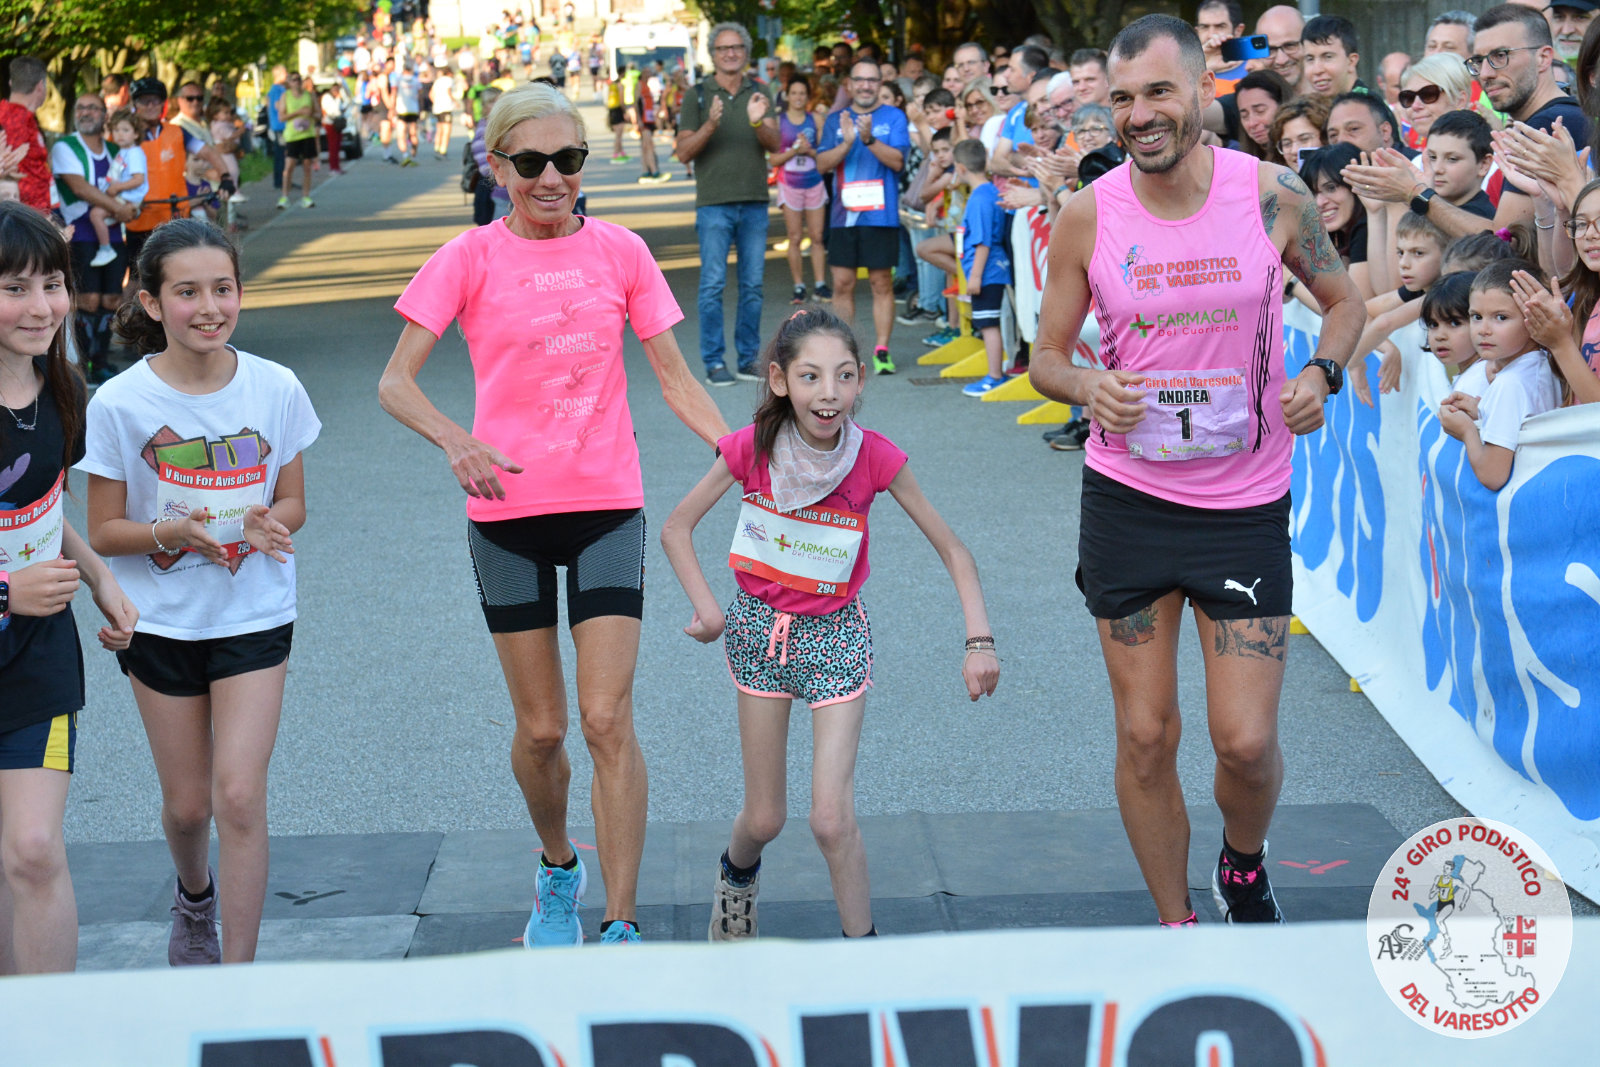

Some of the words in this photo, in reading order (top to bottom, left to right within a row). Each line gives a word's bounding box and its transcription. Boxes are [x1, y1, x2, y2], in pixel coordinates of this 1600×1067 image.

[1134, 263, 1164, 278] GIRO
[1166, 257, 1238, 275] PODISTICO
[534, 269, 584, 286] DONNE
[536, 284, 548, 293] IN
[550, 278, 587, 293] CORSA
[1137, 277, 1160, 292] DEL
[1165, 270, 1242, 289] VARESOTTO
[1157, 308, 1239, 329] FARMACIA
[1158, 328, 1177, 338] Del
[1182, 322, 1239, 336] Cuoricino
[544, 331, 598, 350] DONNE
[546, 347, 558, 356] IN
[560, 341, 598, 355] CORSA
[1145, 377, 1168, 389] Giro
[1169, 376, 1187, 388] del
[1157, 389, 1211, 405] ANDREA
[554, 411, 566, 419] IN
[1175, 406, 1193, 442] 1
[165, 467, 173, 479] V
[173, 471, 194, 485] Run
[196, 475, 214, 487] For
[215, 475, 236, 487] Avis
[237, 474, 245, 485] di
[246, 471, 262, 482] Sera
[15, 511, 32, 526] For
[756, 493, 777, 510] Run
[821, 513, 831, 523] di
[833, 514, 858, 528] Sera
[793, 540, 848, 559] FARMACIA
[816, 582, 837, 595] 294
